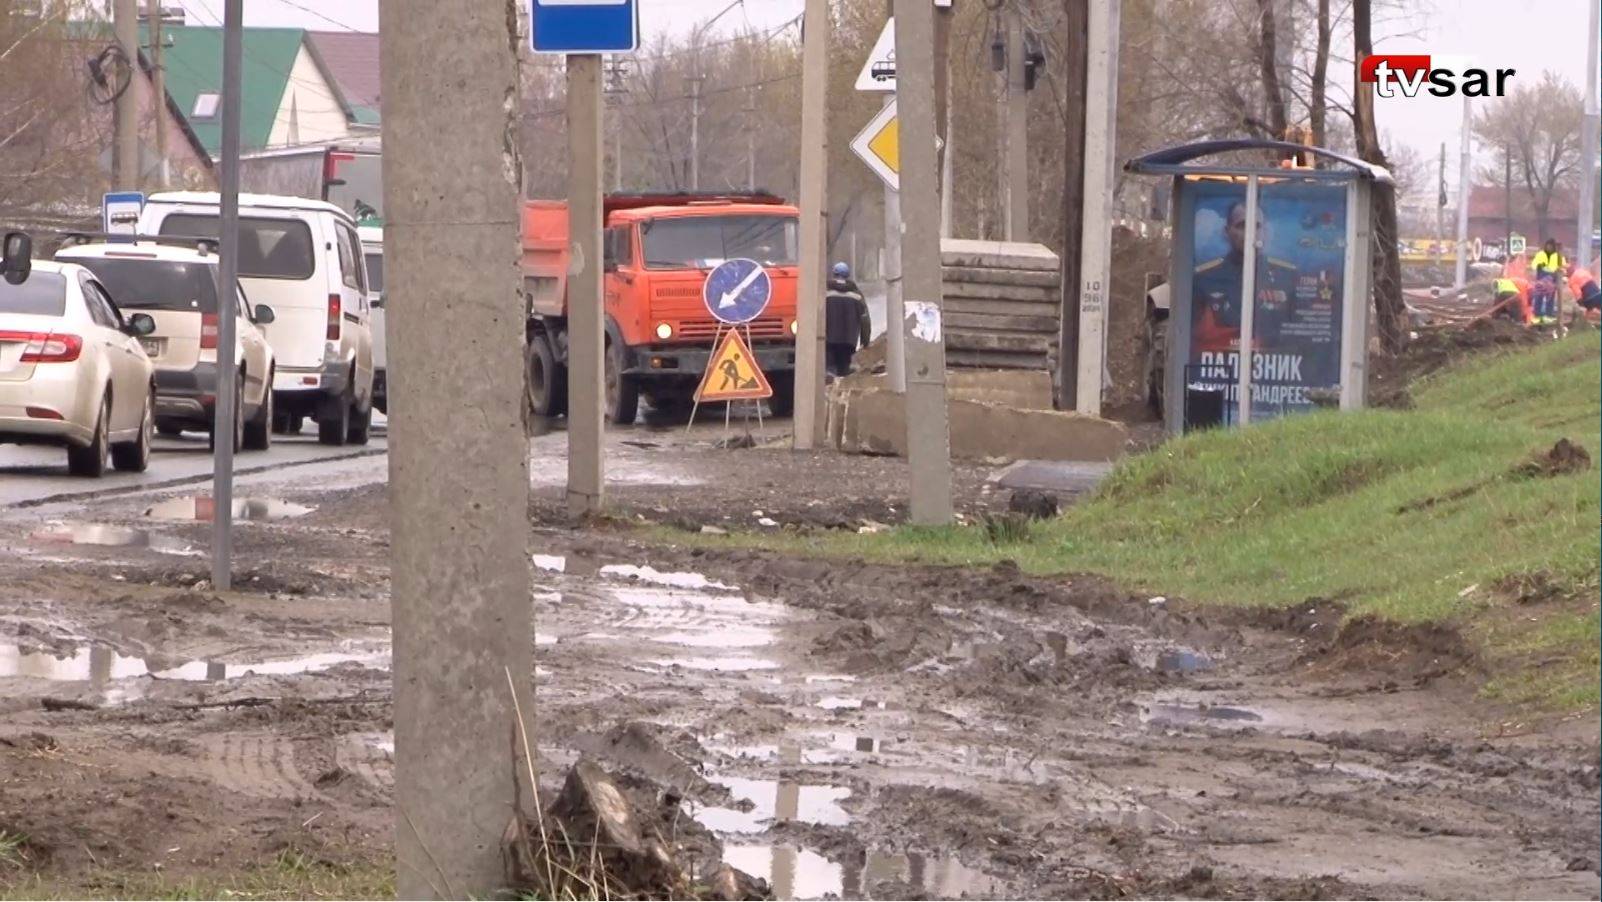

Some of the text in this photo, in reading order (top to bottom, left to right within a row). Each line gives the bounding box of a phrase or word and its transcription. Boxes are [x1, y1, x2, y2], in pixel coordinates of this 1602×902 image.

[1086, 281, 1100, 291] 10
[1201, 352, 1302, 381] ПАЛЗНИК
[1252, 384, 1314, 404] АНДРЕЕ
